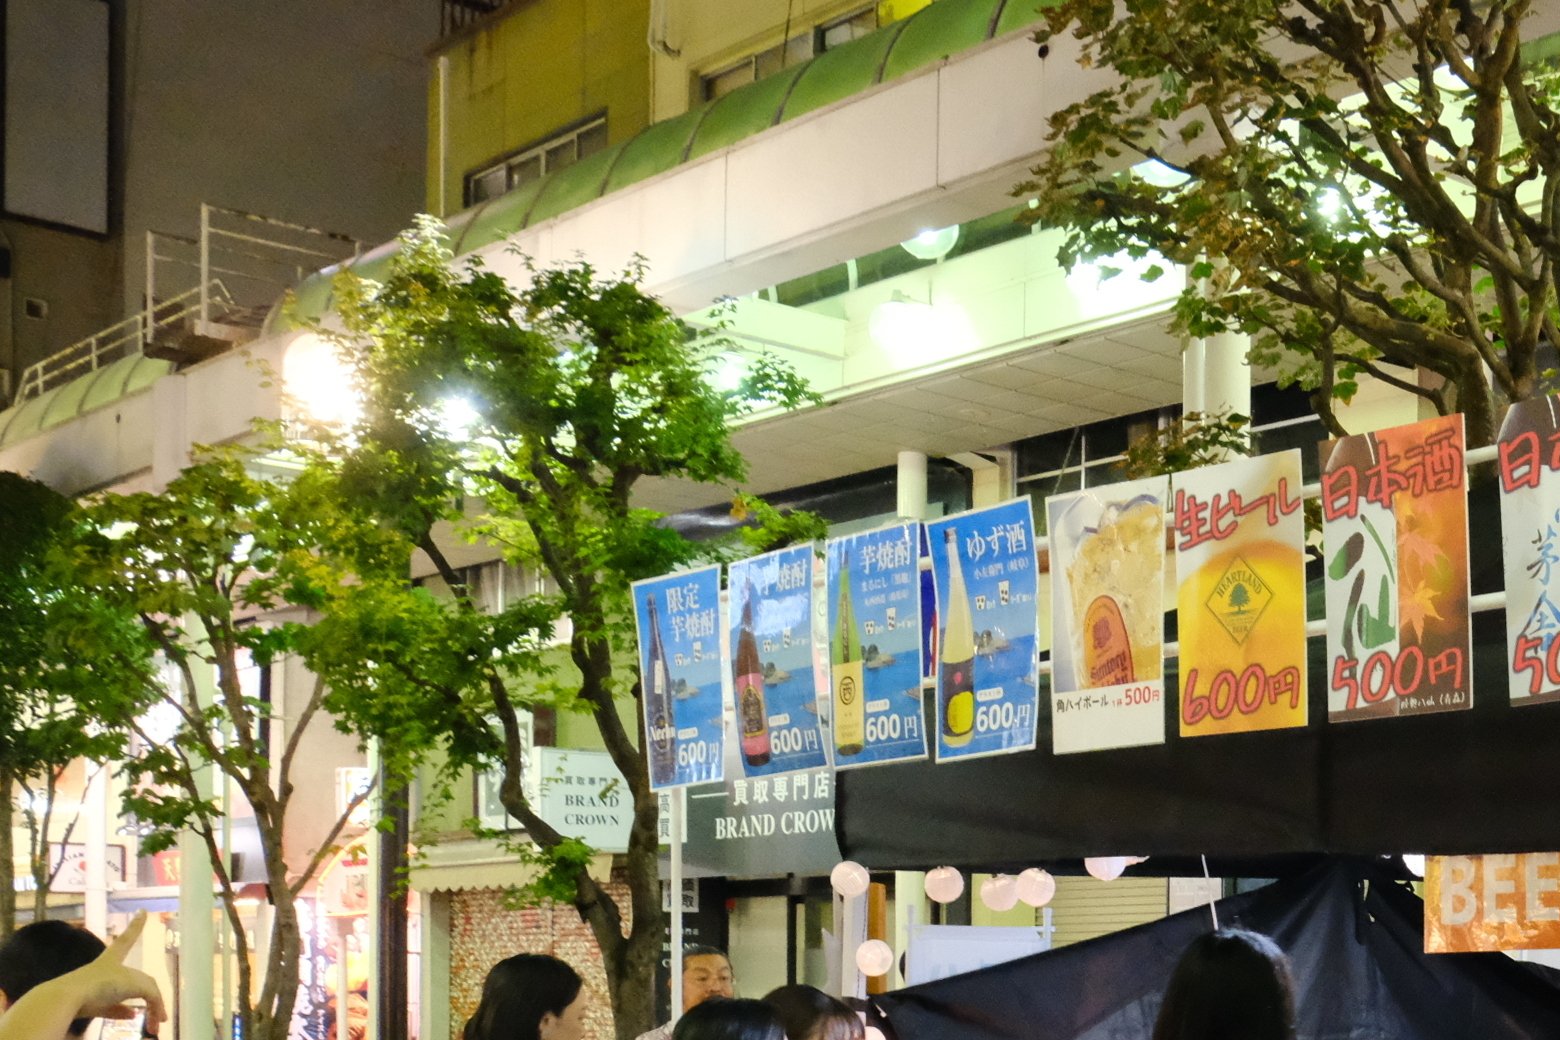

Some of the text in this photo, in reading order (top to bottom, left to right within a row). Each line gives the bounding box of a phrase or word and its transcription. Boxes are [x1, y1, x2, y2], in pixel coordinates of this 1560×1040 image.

[1321, 428, 1463, 524] 日本酒
[1175, 478, 1301, 551] 生ビール
[860, 537, 913, 575] 芋焼酎
[966, 520, 1026, 561] ゆず酒
[665, 582, 700, 613] 限定
[1216, 570, 1263, 598] HEARTLAND
[670, 607, 715, 642] 芋焼酎
[1331, 645, 1463, 711] 500円
[1056, 694, 1109, 713] 角ハイボール
[1182, 663, 1300, 726] 600円
[866, 713, 918, 742] 600円
[975, 702, 1031, 733] 600円
[678, 740, 720, 766] 600円
[770, 727, 818, 755] 600円
[564, 775, 618, 787] 買取専門
[732, 771, 830, 807] 買取専門店
[564, 794, 620, 808] BRAND
[564, 813, 620, 827] CROWN
[715, 813, 776, 840] BRAND
